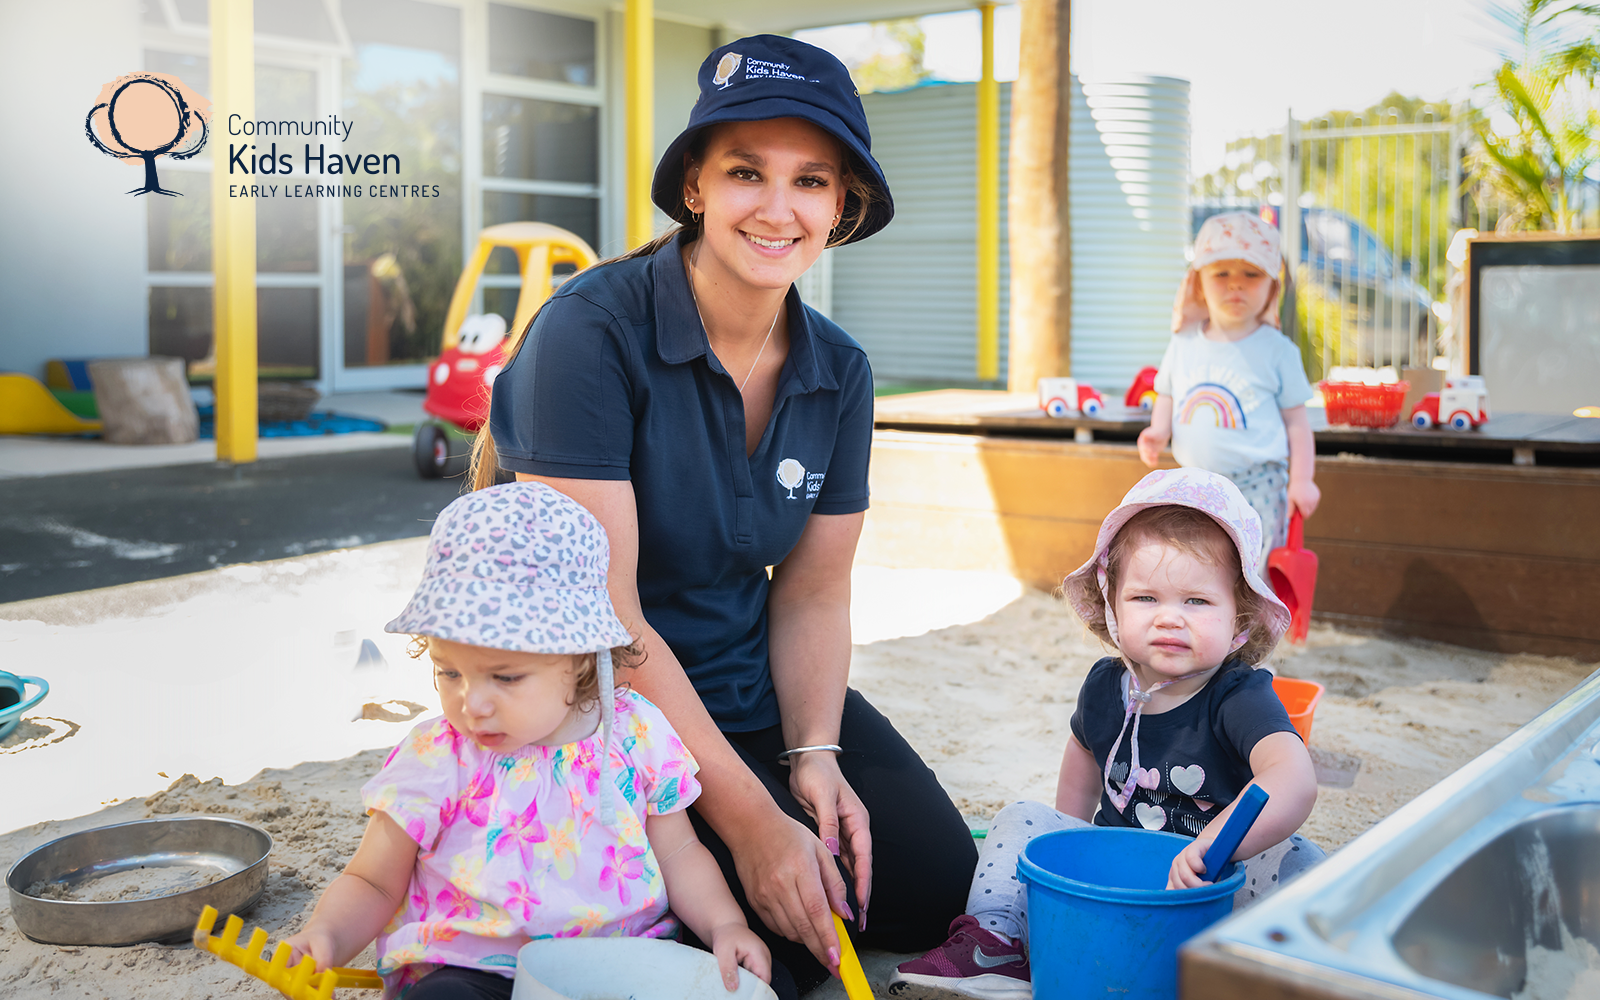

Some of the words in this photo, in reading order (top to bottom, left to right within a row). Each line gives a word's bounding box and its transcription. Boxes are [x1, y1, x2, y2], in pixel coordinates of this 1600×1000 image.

[746, 57, 790, 71] Community
[745, 65, 770, 75] Kids
[771, 69, 805, 81] Haven
[806, 480, 821, 492] Kids
